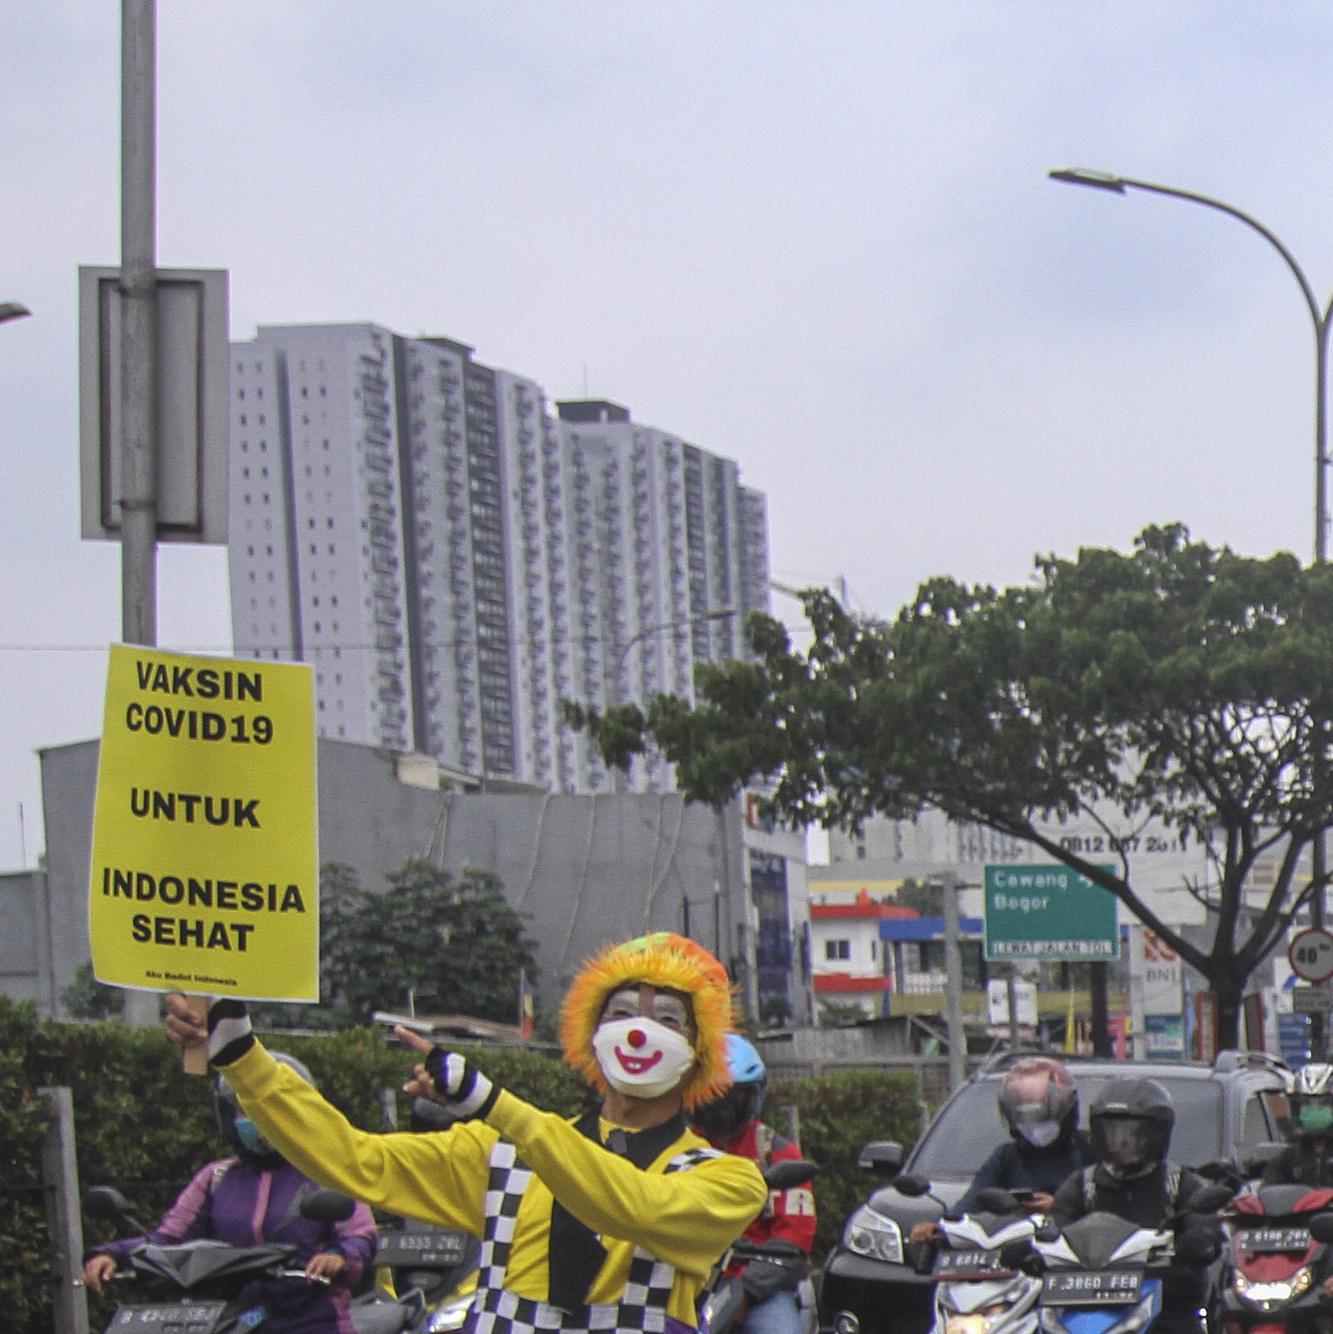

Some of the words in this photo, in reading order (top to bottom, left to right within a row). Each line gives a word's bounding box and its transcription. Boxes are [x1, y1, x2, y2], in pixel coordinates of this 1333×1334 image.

[136, 660, 263, 703] VAKSIN
[126, 702, 274, 745] COVID19
[129, 786, 261, 829] UNTUK
[102, 867, 306, 913] INDONESIA
[993, 871, 1068, 890] Cawang
[993, 893, 1050, 914] Bogor
[131, 914, 255, 952] SEHAT
[1048, 1277, 1057, 1290] F
